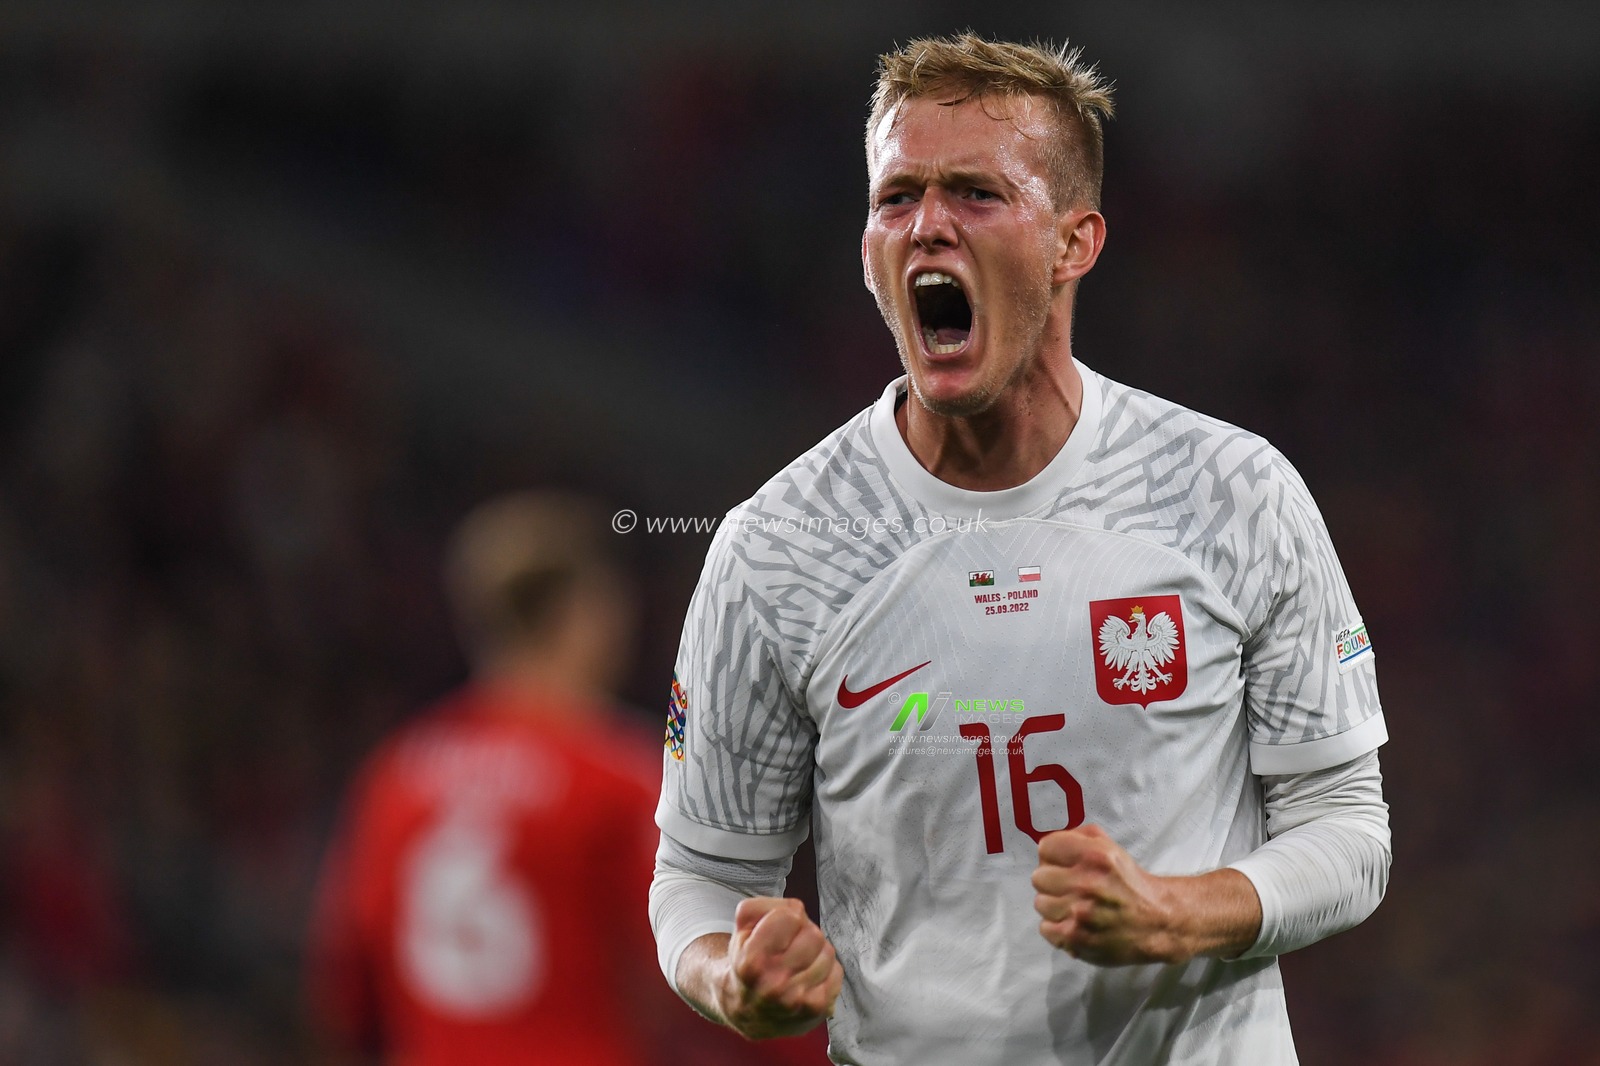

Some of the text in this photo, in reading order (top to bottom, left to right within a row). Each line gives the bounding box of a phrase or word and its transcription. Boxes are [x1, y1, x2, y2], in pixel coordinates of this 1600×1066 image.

[974, 593, 1001, 604] WALES
[1007, 589, 1038, 601] POLAND
[985, 602, 1029, 615] 25.09.2022
[959, 713, 1085, 854] 16
[398, 808, 545, 1015] 6
